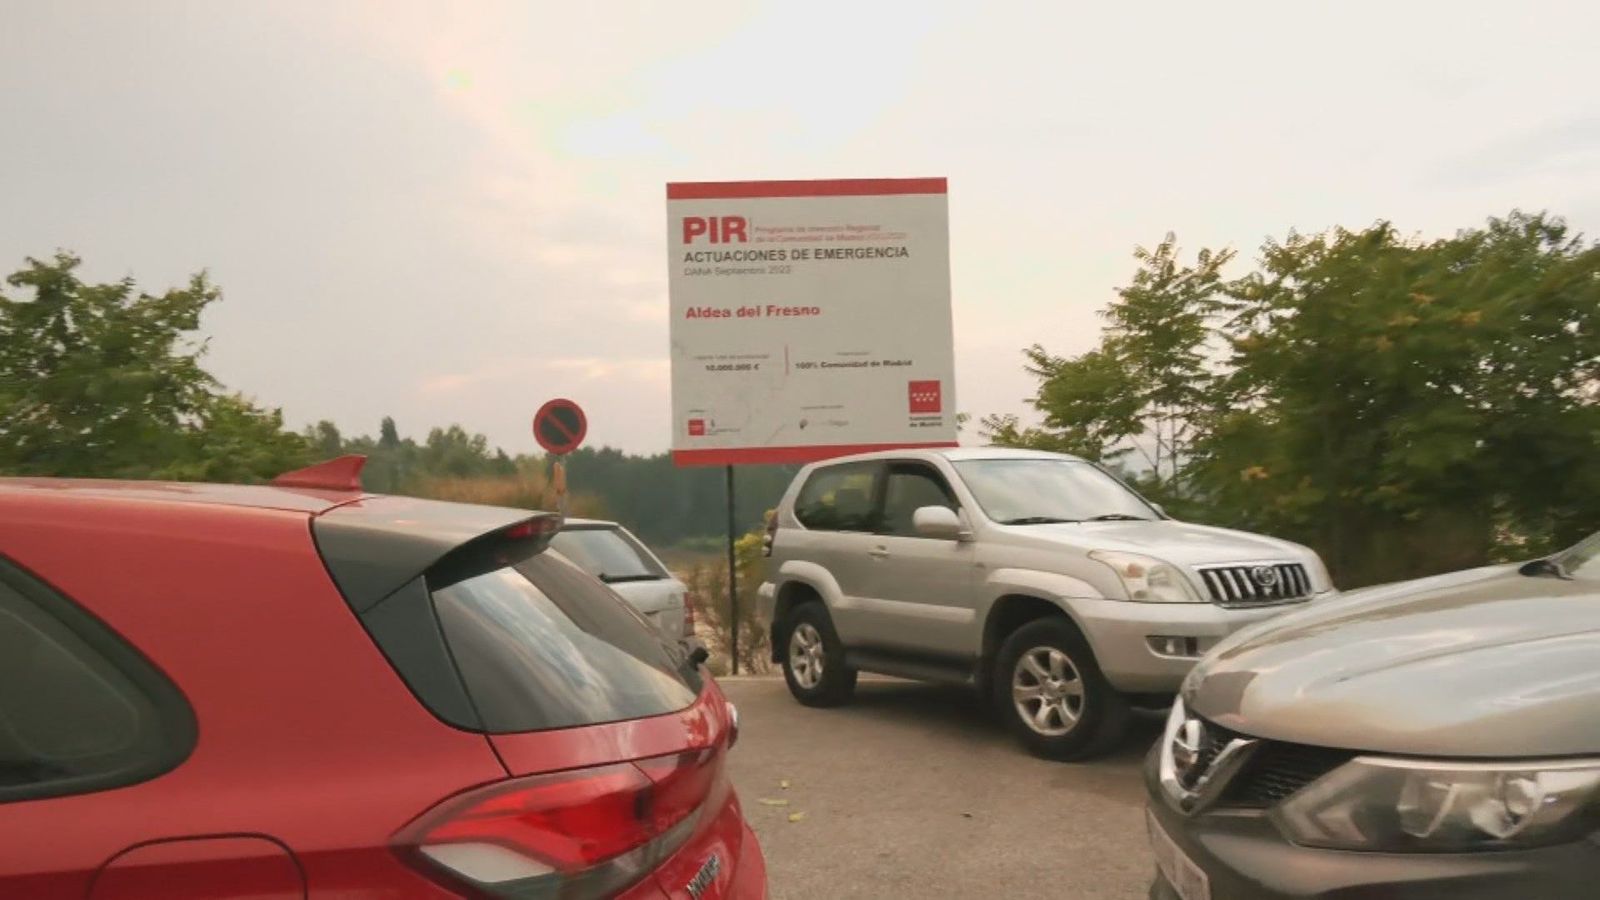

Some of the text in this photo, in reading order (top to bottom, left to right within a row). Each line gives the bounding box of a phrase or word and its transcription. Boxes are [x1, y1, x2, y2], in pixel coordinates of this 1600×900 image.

[683, 216, 748, 244] PIR
[684, 246, 909, 263] ACTUACIONES DE EMERGENCIA
[685, 304, 820, 319] Aldea del Fresno
